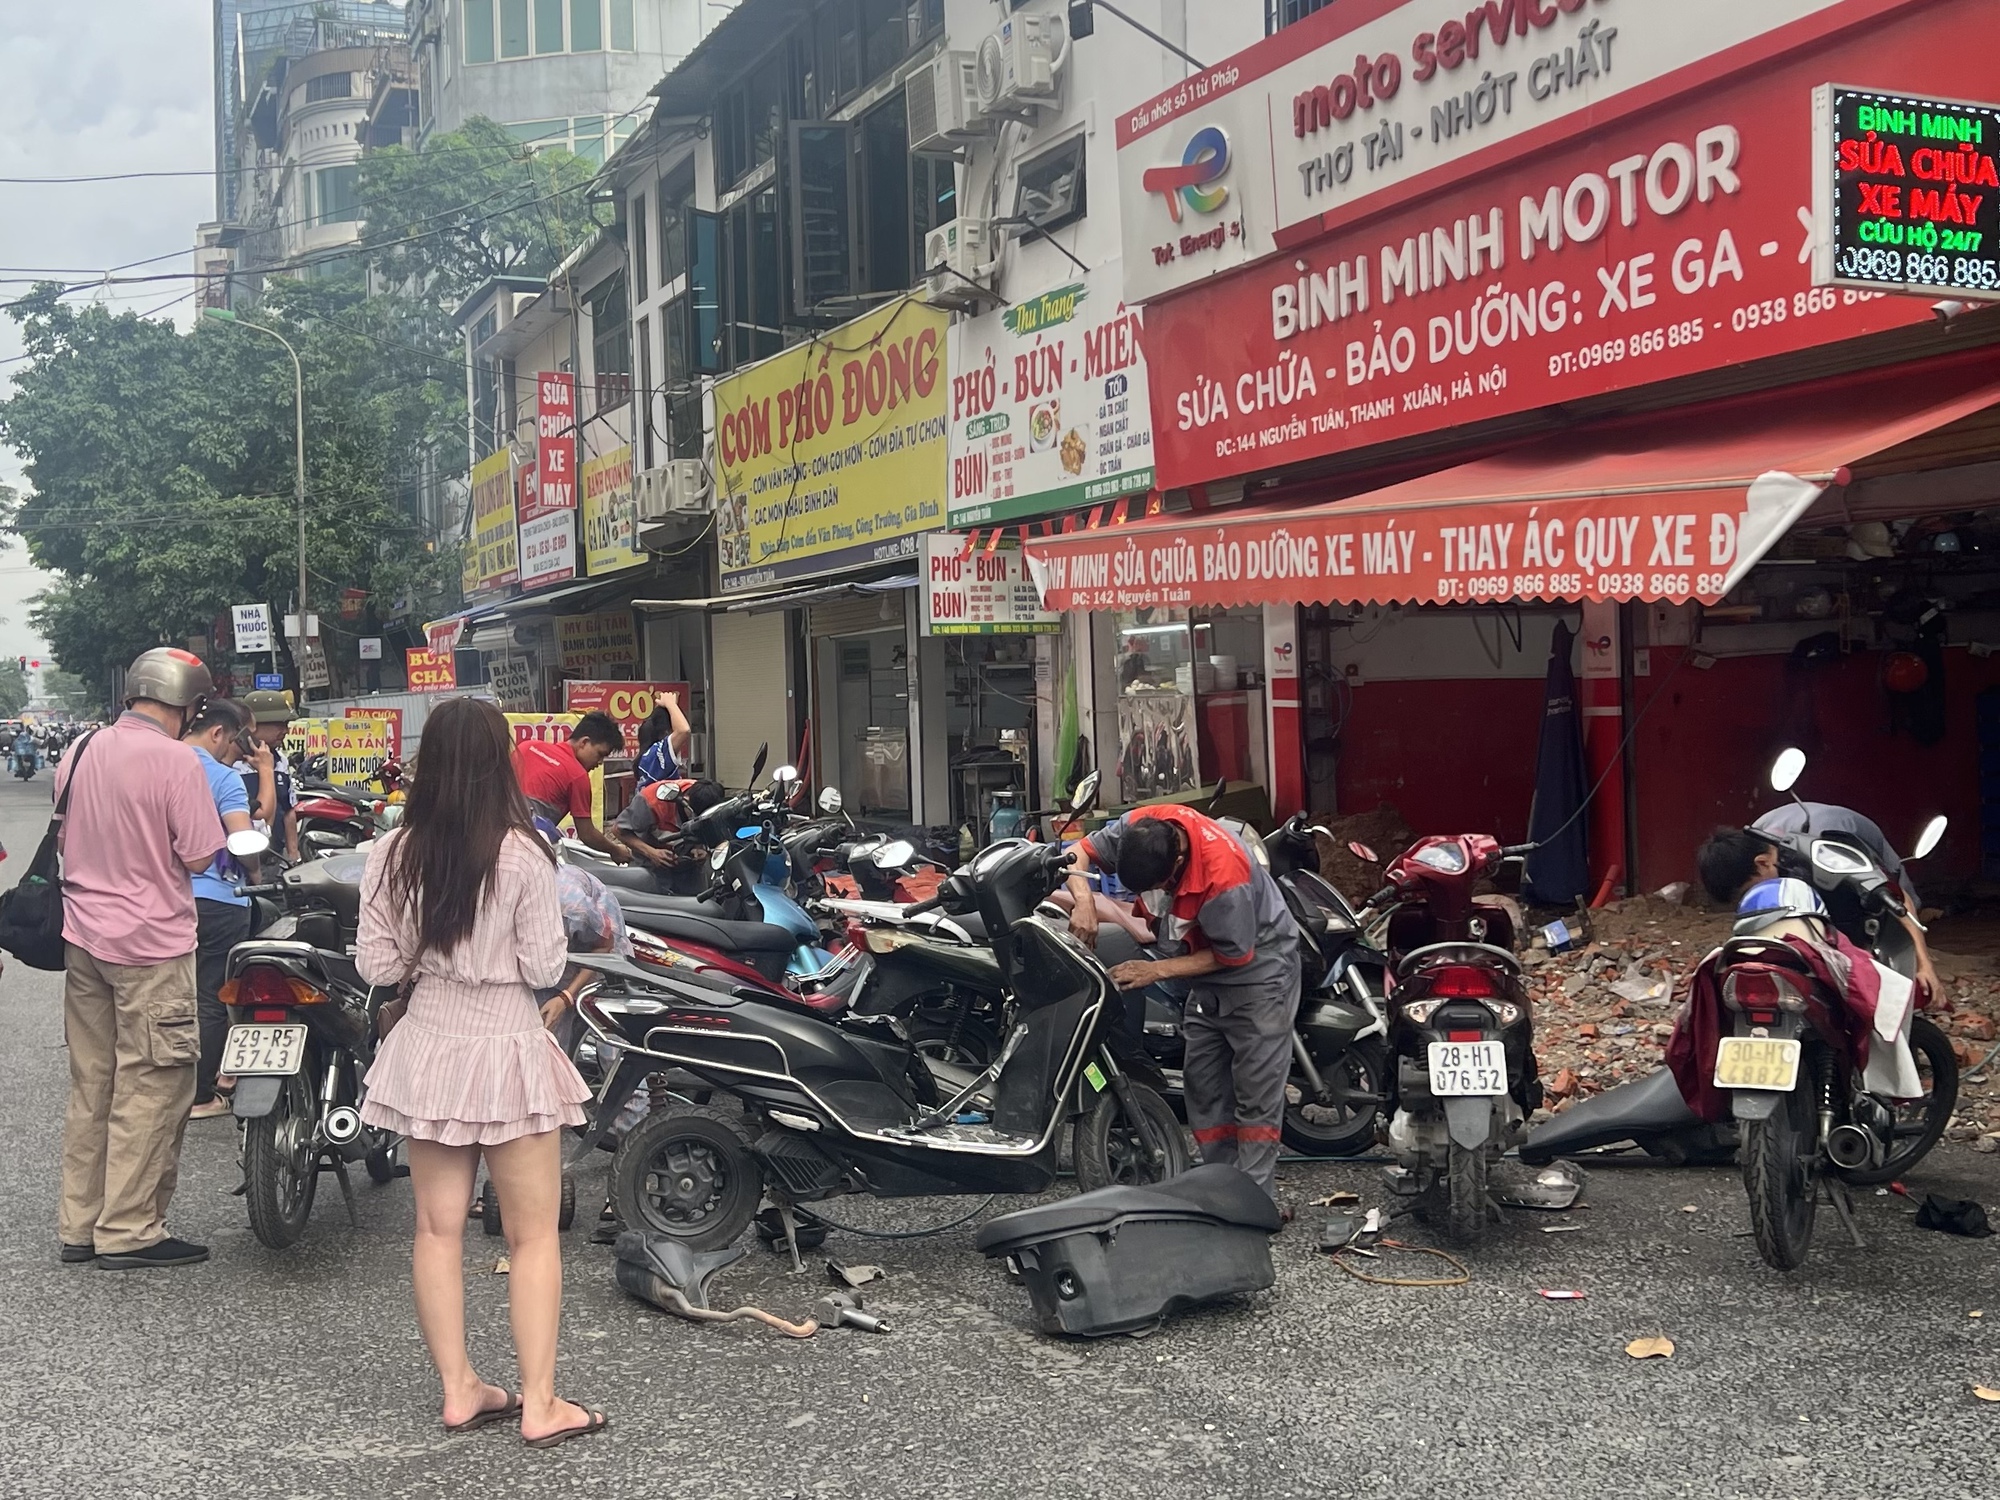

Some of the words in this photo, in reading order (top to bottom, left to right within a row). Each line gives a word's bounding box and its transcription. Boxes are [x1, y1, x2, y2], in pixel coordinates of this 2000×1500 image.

[1293, 53, 1401, 138] moto
[1411, 0, 1610, 82] servic
[1430, 71, 1518, 143] NHỚT
[1528, 18, 1617, 101] CHẤT
[1175, 83, 1187, 109] số
[1188, 84, 1194, 102] 1
[1211, 65, 1239, 92] Pháp
[1858, 101, 1916, 136] BÌNH
[1921, 112, 1982, 144] MINH
[1839, 130, 1906, 177] SỬA
[1858, 182, 1902, 218] XE
[1909, 183, 1983, 226] MÁY
[1272, 259, 1368, 341] BÌNH
[1381, 206, 1504, 304] MINH
[1519, 125, 1741, 261] MOTOR
[1907, 220, 1938, 253] HỘ
[1941, 229, 1983, 252] 24/7
[1906, 252, 1949, 281] 866
[1953, 257, 1997, 286] 885
[1016, 304, 1037, 333] Thu
[1040, 292, 1076, 325] Trang
[1629, 327, 1665, 358] 866
[1668, 317, 1704, 348] 885
[1731, 297, 1788, 333] 0938
[1793, 286, 1837, 318] 866
[1176, 373, 1229, 432] SỬA
[1236, 349, 1317, 416] CHỮA
[1346, 318, 1416, 386] BẢO
[1429, 281, 1582, 365] DƯỠNG:
[1597, 252, 1656, 319] XE
[1671, 228, 1743, 295] GA
[543, 374, 569, 405] SỬA
[953, 346, 996, 422] PHỞ
[1014, 333, 1065, 404] BÚN
[721, 393, 772, 468] CƠM
[777, 341, 835, 449] PHỐ
[842, 327, 940, 427] ĐÔNG
[1349, 397, 1395, 425] THANH
[1402, 382, 1448, 413] XUÂN,
[1451, 376, 1473, 401] HÀ
[1478, 363, 1508, 396] NỘI
[919, 414, 946, 444] CHỌN
[548, 449, 565, 472] XE
[954, 446, 983, 499] BÚN
[543, 478, 571, 506] MÁY
[900, 536, 915, 555] 098
[1070, 552, 1108, 590] MINH
[1113, 537, 1146, 586] SỬA
[1150, 537, 1198, 584] CHỮA
[1203, 528, 1241, 582] BẢO
[1246, 528, 1319, 580] DƯỠNG
[1324, 533, 1355, 577] XE
[1362, 519, 1416, 576] MÁY
[1440, 522, 1514, 573] THAY
[1522, 506, 1565, 568] ÁC
[1575, 515, 1640, 576] QUY
[1647, 514, 1697, 566] XE
[1072, 592, 1090, 606] ĐC:
[1093, 591, 1115, 604] 142
[1438, 578, 1464, 598] ĐT:
[1468, 576, 1508, 596] 0969
[1512, 573, 1544, 595] 866
[1549, 573, 1582, 594] 885
[1598, 573, 1644, 595] 0938
[1649, 573, 1690, 595] 866
[1696, 572, 1728, 595] 88
[240, 609, 261, 620] NHÀ
[933, 587, 962, 618] BÚN
[236, 620, 267, 633] THUỐC
[411, 664, 454, 684] CHẢ
[331, 734, 353, 749] GÀ
[331, 753, 357, 774] BÁNH
[239, 1029, 294, 1048] 29-R5
[234, 1049, 289, 1069] 5743
[1441, 1046, 1493, 1068] 28-H1
[1436, 1069, 1501, 1091] 076.52
